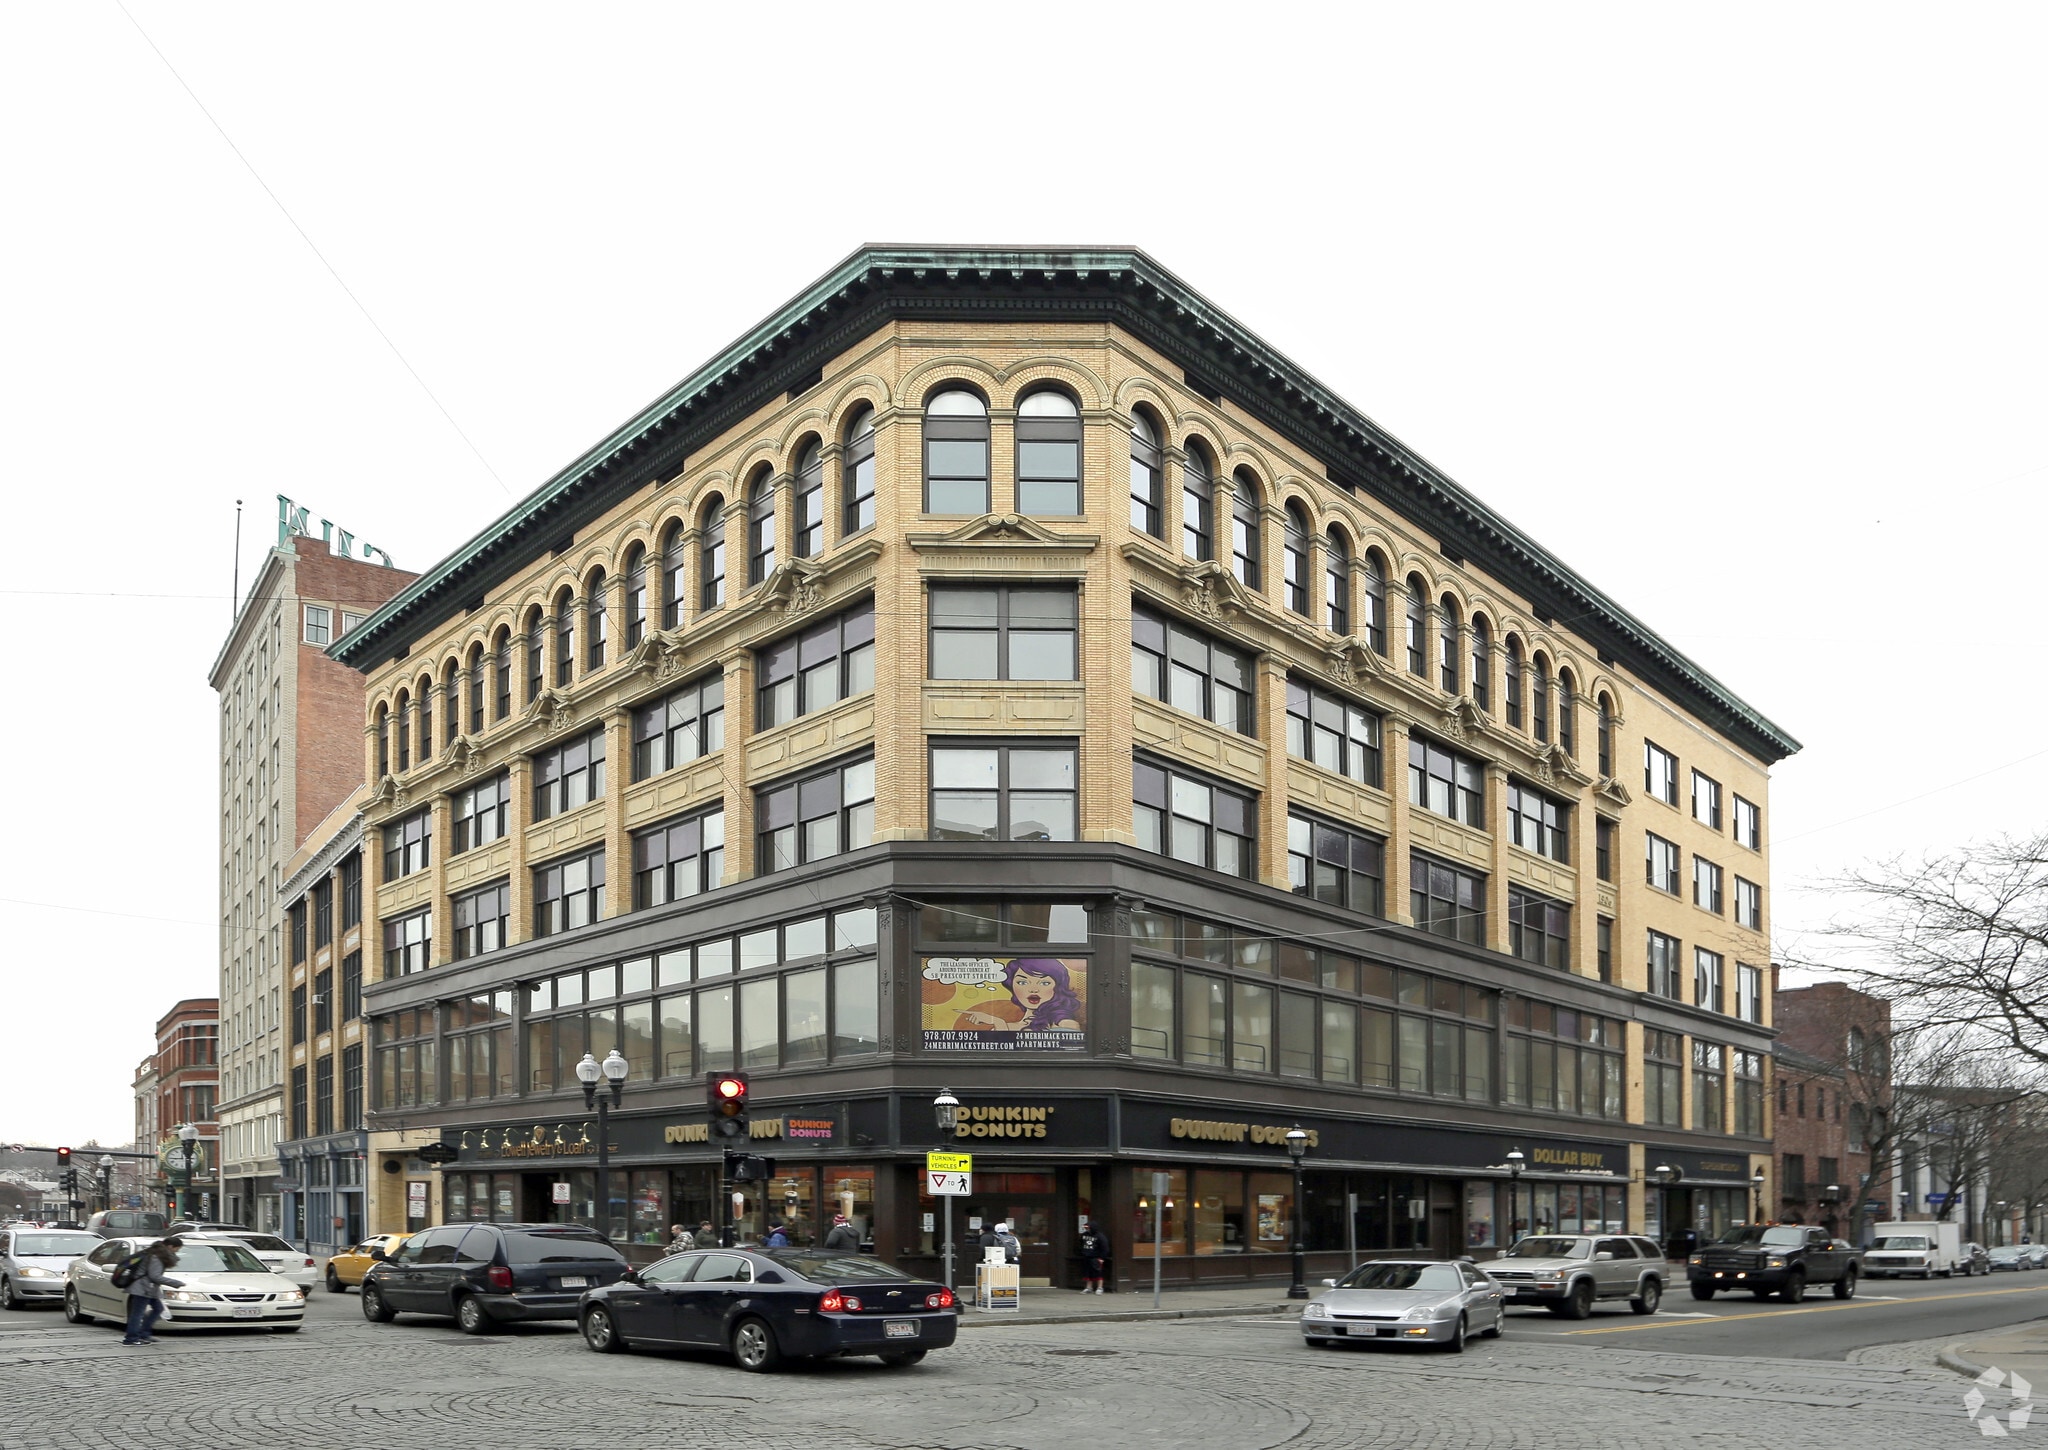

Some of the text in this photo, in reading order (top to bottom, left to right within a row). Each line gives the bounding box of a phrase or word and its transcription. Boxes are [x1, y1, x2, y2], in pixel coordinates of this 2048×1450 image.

[924, 1031, 979, 1041] 978.707.9924
[1016, 1032, 1085, 1040] 24 MERRIMACK STREET
[924, 1041, 1014, 1050] 24MERRIMACKSTREET.COM
[955, 1106, 1055, 1121] DUNKIN'
[789, 1119, 834, 1129] DUNKIN'
[955, 1123, 1047, 1138] DONUTS
[1170, 1118, 1249, 1142] DUNKIN'
[665, 1124, 708, 1143] DUNK
[790, 1129, 832, 1138] DONUTS
[563, 1140, 586, 1155] Loan
[1534, 1148, 1602, 1167] DOLLAR BUY
